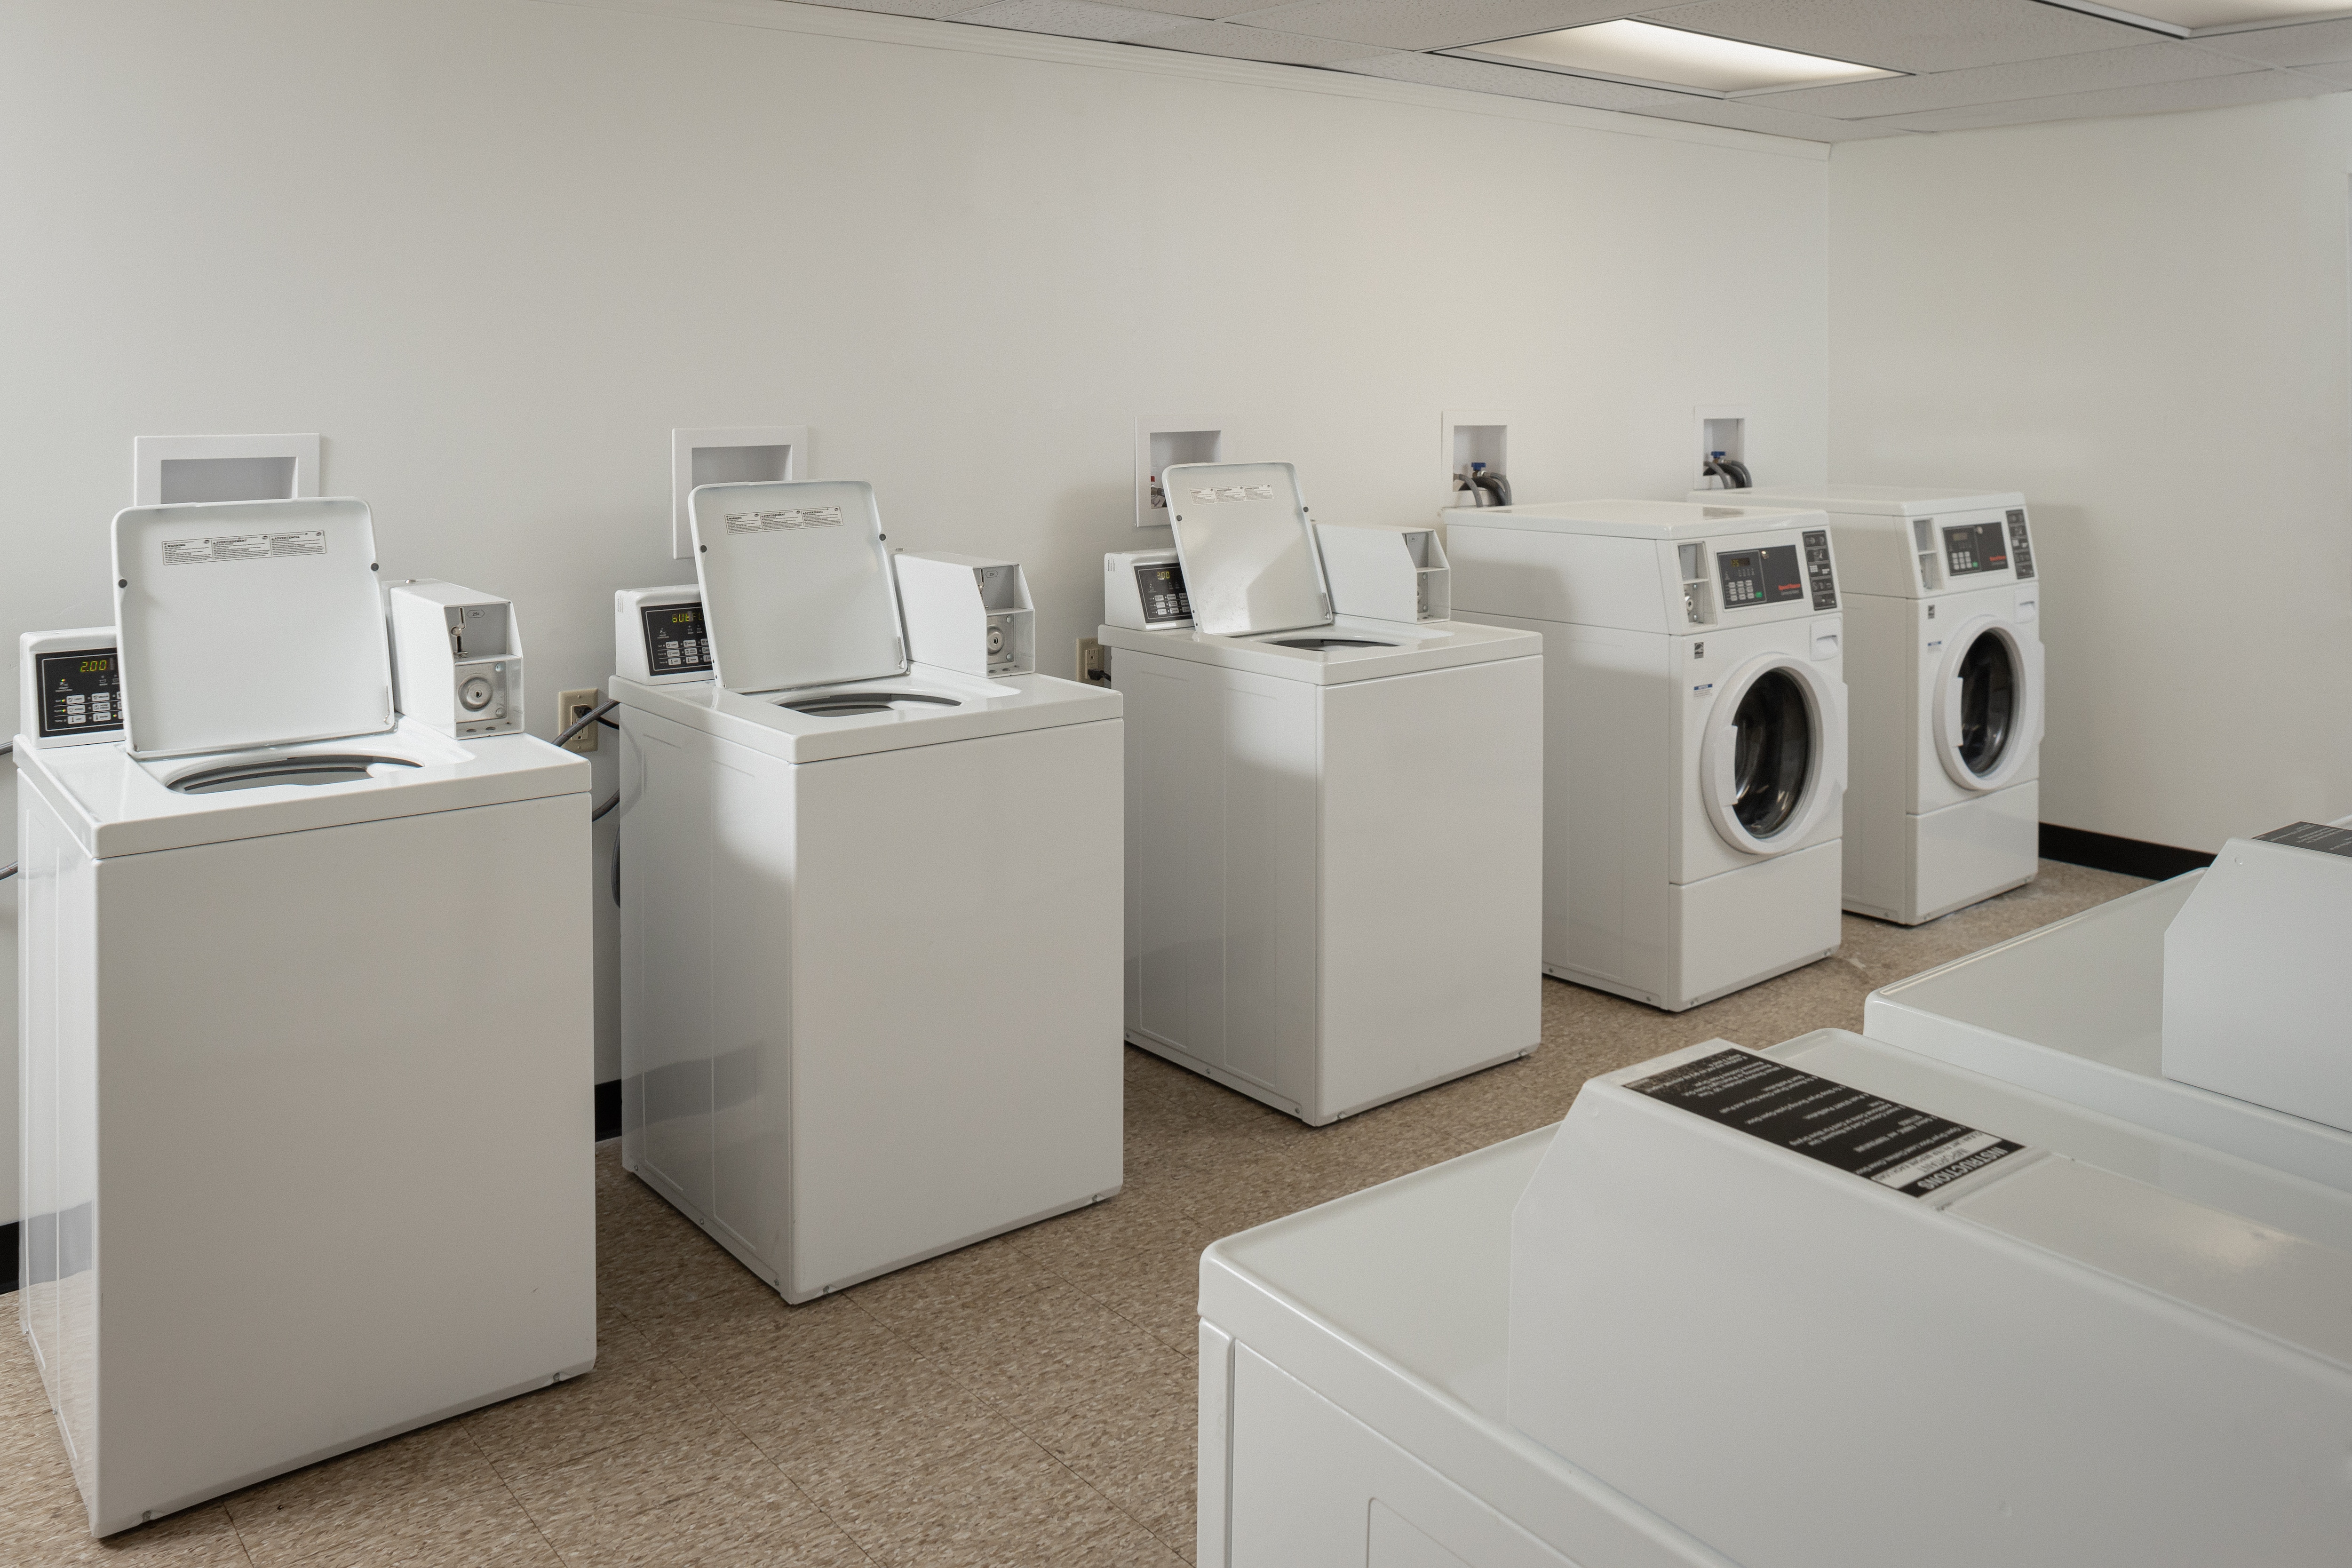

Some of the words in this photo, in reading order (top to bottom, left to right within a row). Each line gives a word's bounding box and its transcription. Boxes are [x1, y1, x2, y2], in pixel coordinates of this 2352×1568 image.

[80, 660, 107, 672] 2.00
[1832, 1099, 1852, 1109] START
[1917, 1146, 2005, 1190] INSTRUCTIONS
[1919, 1147, 1970, 1173] IMPORTANT
